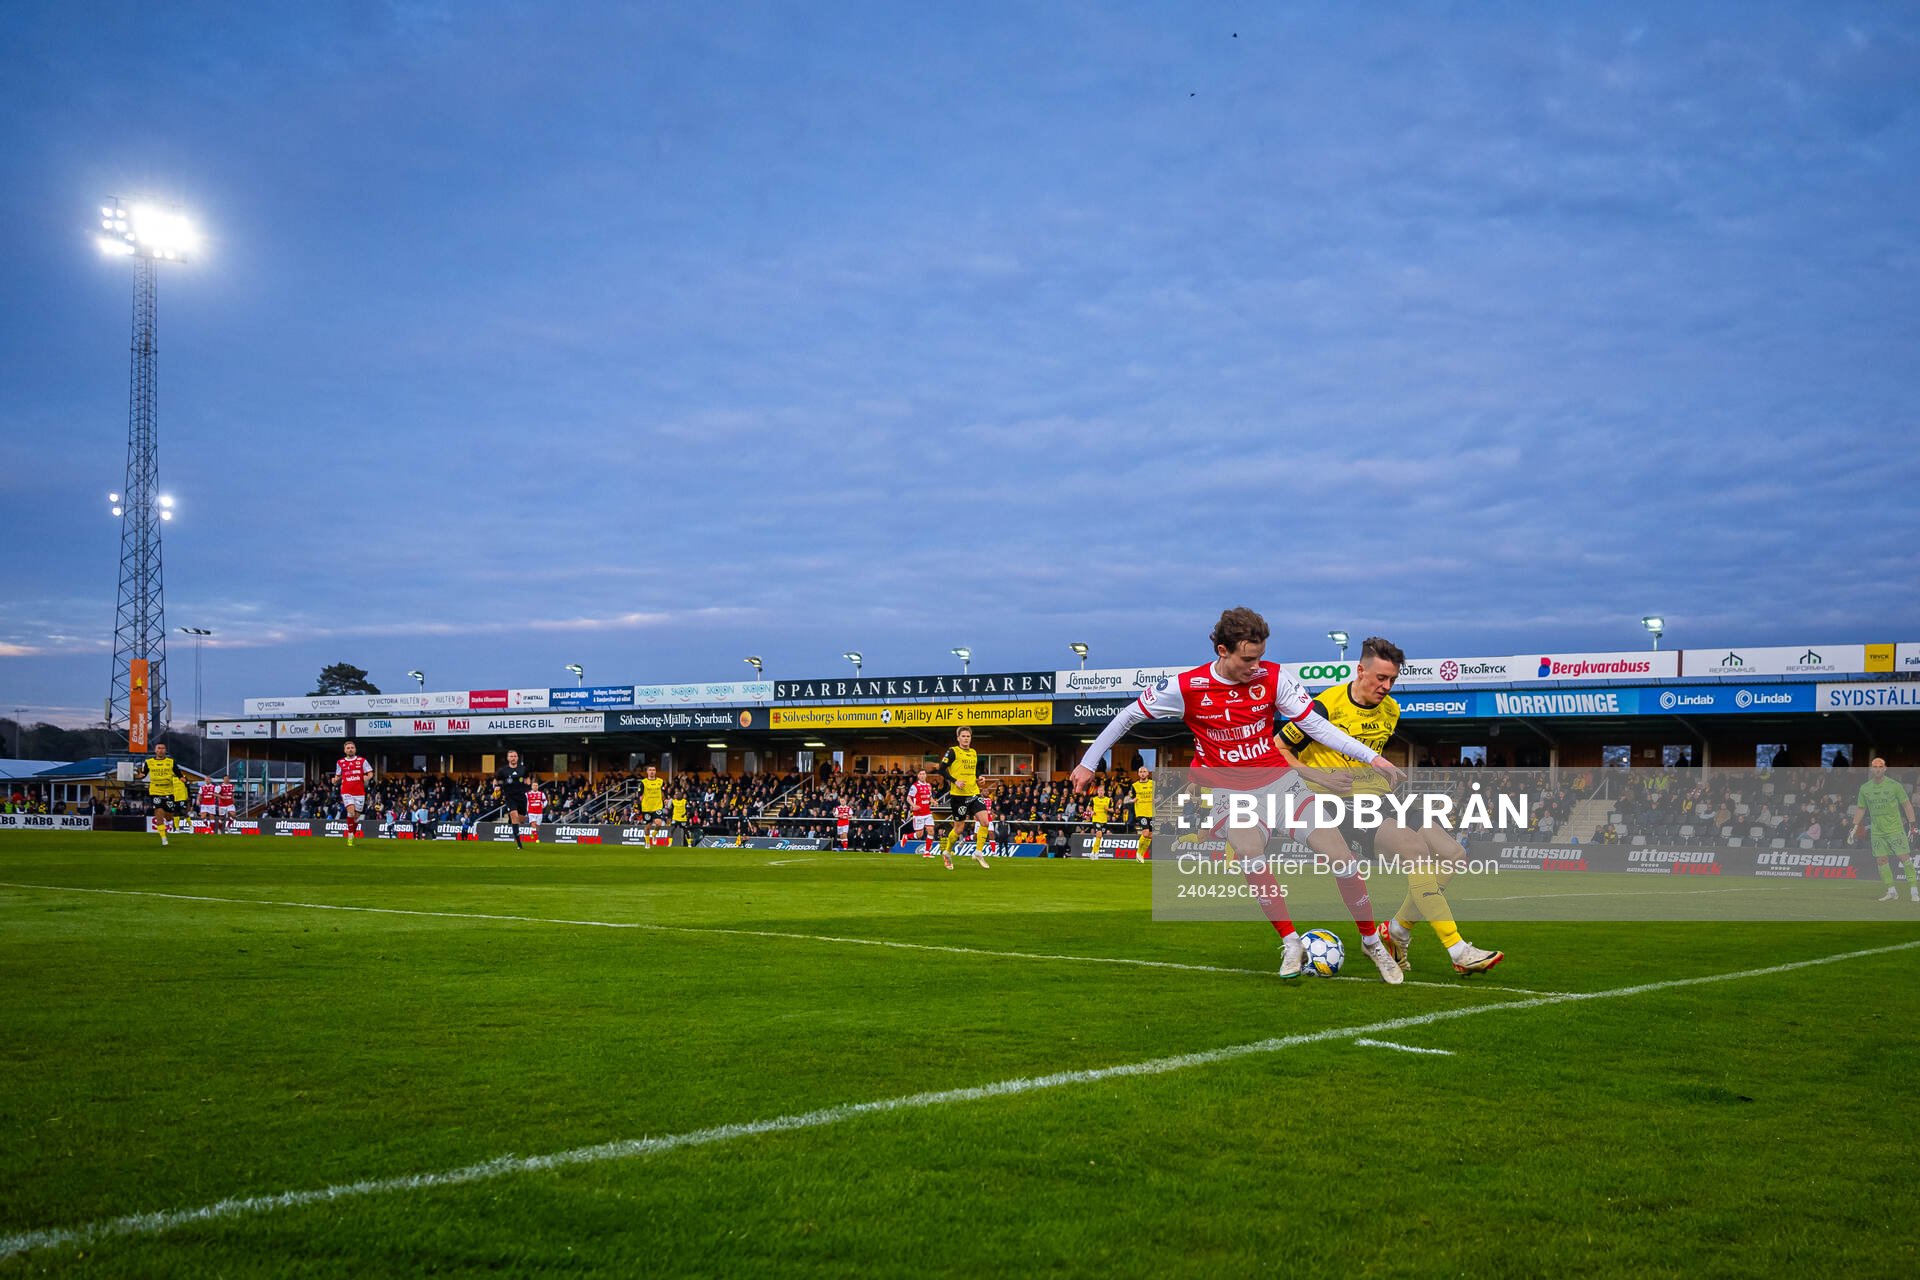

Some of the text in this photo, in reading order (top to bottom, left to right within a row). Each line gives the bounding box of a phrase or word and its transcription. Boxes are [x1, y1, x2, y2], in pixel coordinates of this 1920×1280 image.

[1299, 664, 1351, 682] coop
[1552, 659, 1651, 677] Bergkvarabuss
[777, 675, 1053, 698] SPARBANKSLÄKTAREN
[1066, 672, 1122, 690] Lönneberga
[1495, 692, 1619, 715] NORRVIDINGE
[1678, 695, 1715, 706] Lindab
[1754, 693, 1793, 704] Lindab
[564, 716, 603, 724] meritum
[620, 712, 733, 727] Sölvesborg-Mjällby Sparbank
[782, 710, 835, 725] Sölvesborgs
[837, 711, 878, 721] kommun
[894, 709, 932, 723] Mjällby
[967, 708, 1032, 721] hemmaplan
[289, 724, 309, 734] Crowe
[324, 723, 343, 734] Crowe
[373, 720, 392, 729] STENA
[414, 720, 436, 731] MAXI
[447, 719, 470, 730] MAXI
[488, 719, 537, 730] AHLBERG
[538, 719, 554, 728] BIL
[1361, 722, 1380, 730] MAXI
[1219, 737, 1271, 763] telink
[1500, 846, 1582, 861] ottosson
[1627, 849, 1715, 863] ottosson
[1756, 851, 1850, 867] ottosson
[1542, 857, 1590, 871] truck
[1671, 861, 1723, 875] truck
[1804, 864, 1858, 879] truck
